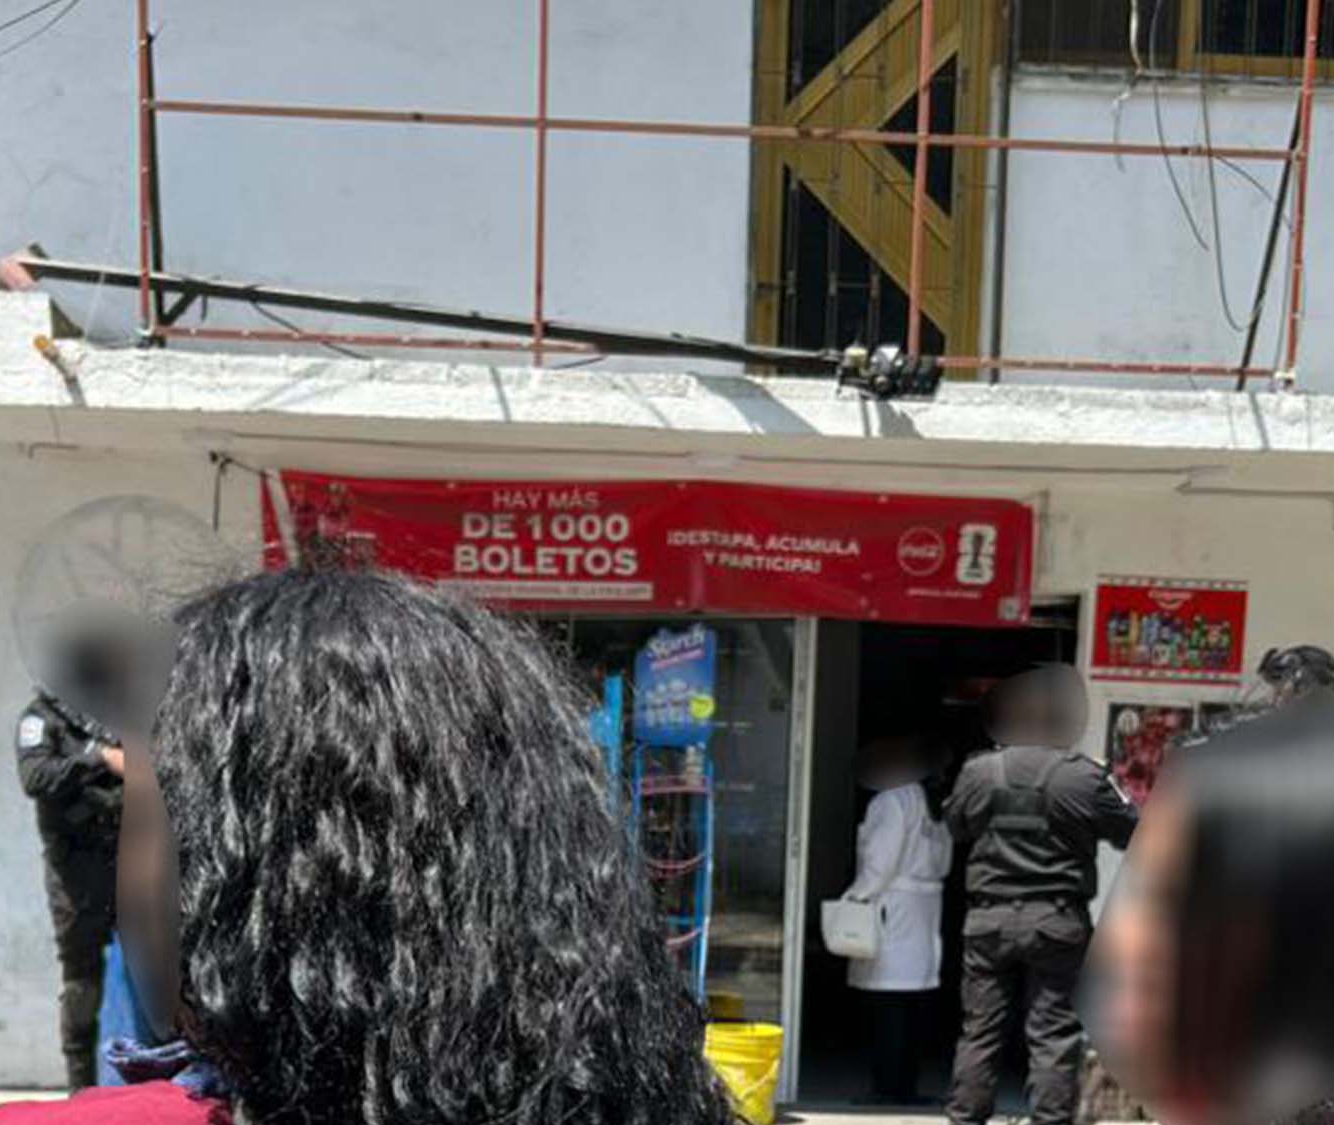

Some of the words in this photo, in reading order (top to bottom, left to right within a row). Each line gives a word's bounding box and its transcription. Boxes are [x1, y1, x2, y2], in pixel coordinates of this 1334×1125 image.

[493, 490, 542, 508] HAY
[547, 485, 600, 509] MÁS
[463, 512, 516, 540] DE
[767, 533, 861, 556] ACUMULA
[454, 543, 639, 576] BOLETOS
[703, 551, 717, 565] Y
[718, 552, 822, 574] PARTICIPA!
